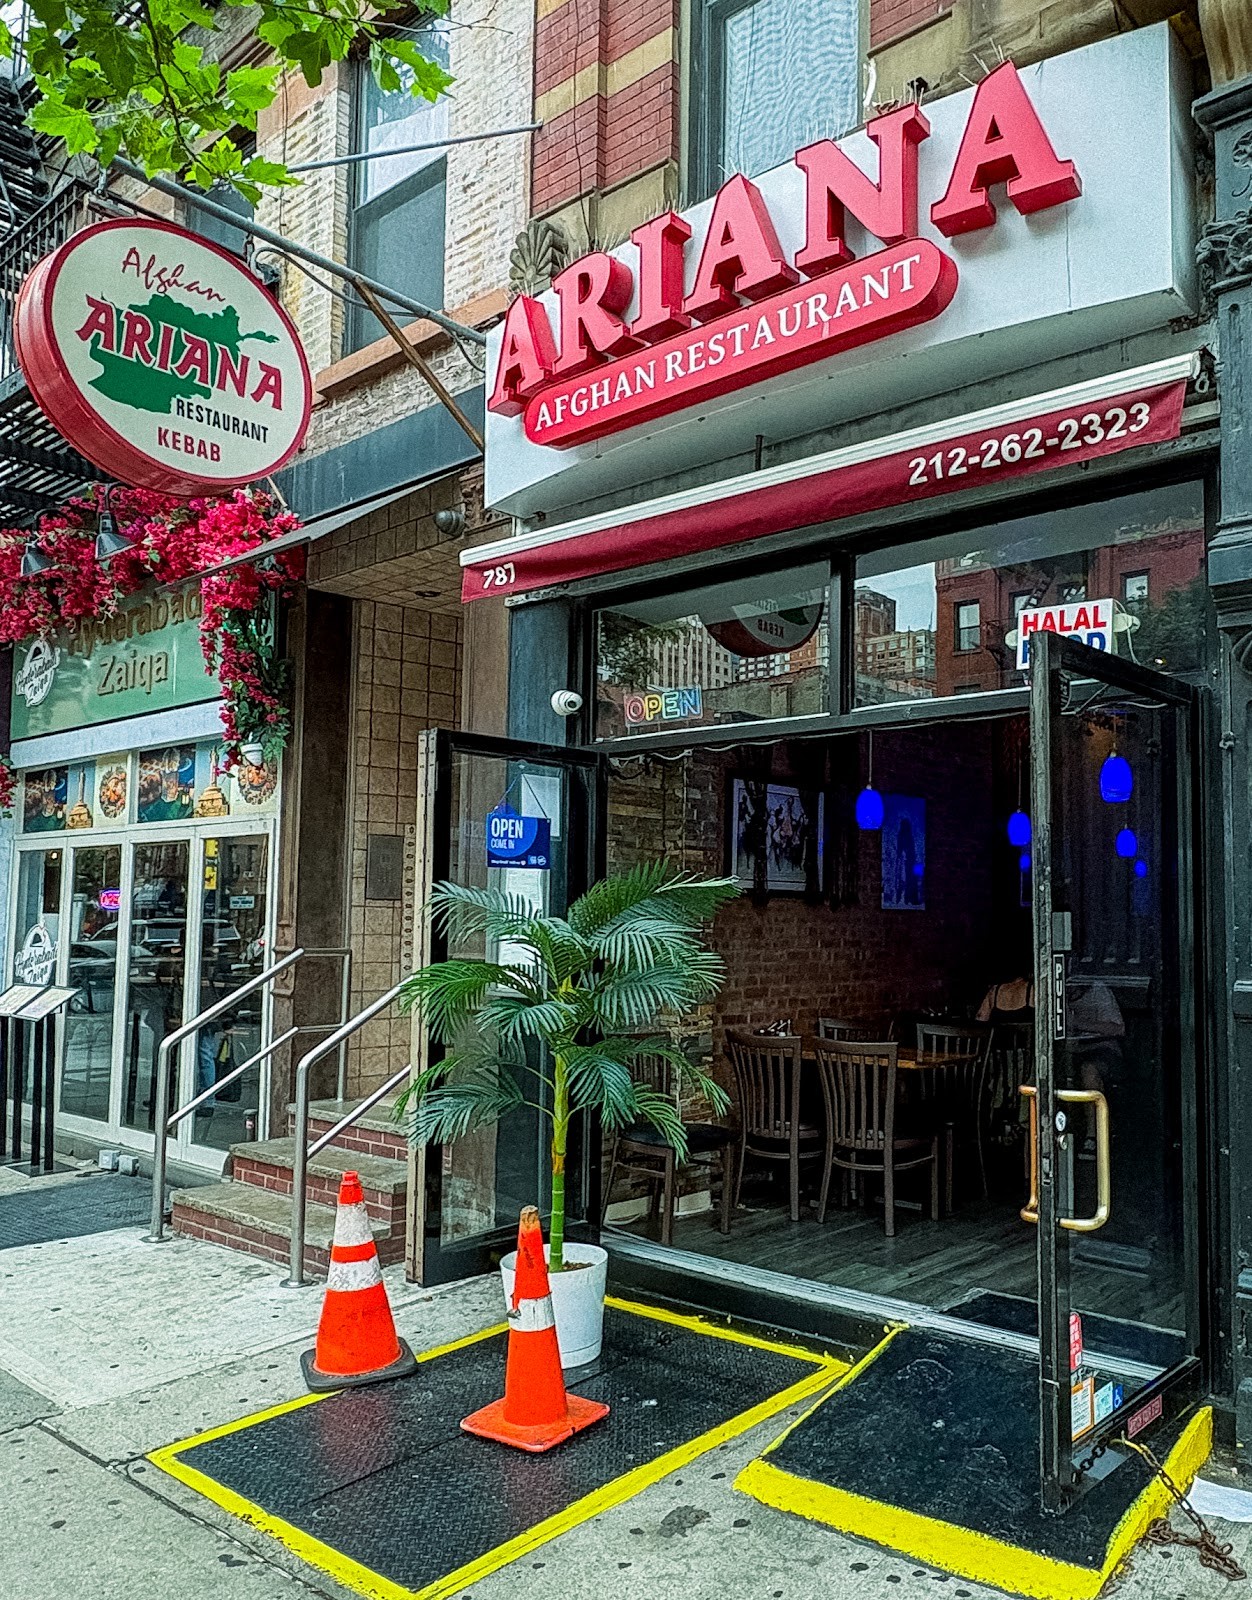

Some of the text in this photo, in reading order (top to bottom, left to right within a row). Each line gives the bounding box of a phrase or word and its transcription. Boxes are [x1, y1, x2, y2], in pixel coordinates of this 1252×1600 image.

[488, 58, 1083, 416] ARIANA
[121, 246, 226, 303] Afghan
[75, 293, 284, 411] ARIANA
[533, 254, 922, 434] AFGHAN RESTAURANT
[175, 397, 269, 444] RESTAURANT
[157, 426, 222, 463] KEBAB
[907, 402, 1150, 486] 212-262-2323
[483, 562, 516, 589] 787
[1022, 605, 1107, 637] HALAL
[97, 650, 168, 695] Zaiqa
[626, 688, 702, 723] OPEN
[491, 817, 524, 839] OPEN
[491, 838, 515, 849] COME IN
[1055, 962, 1063, 1032] PULL
